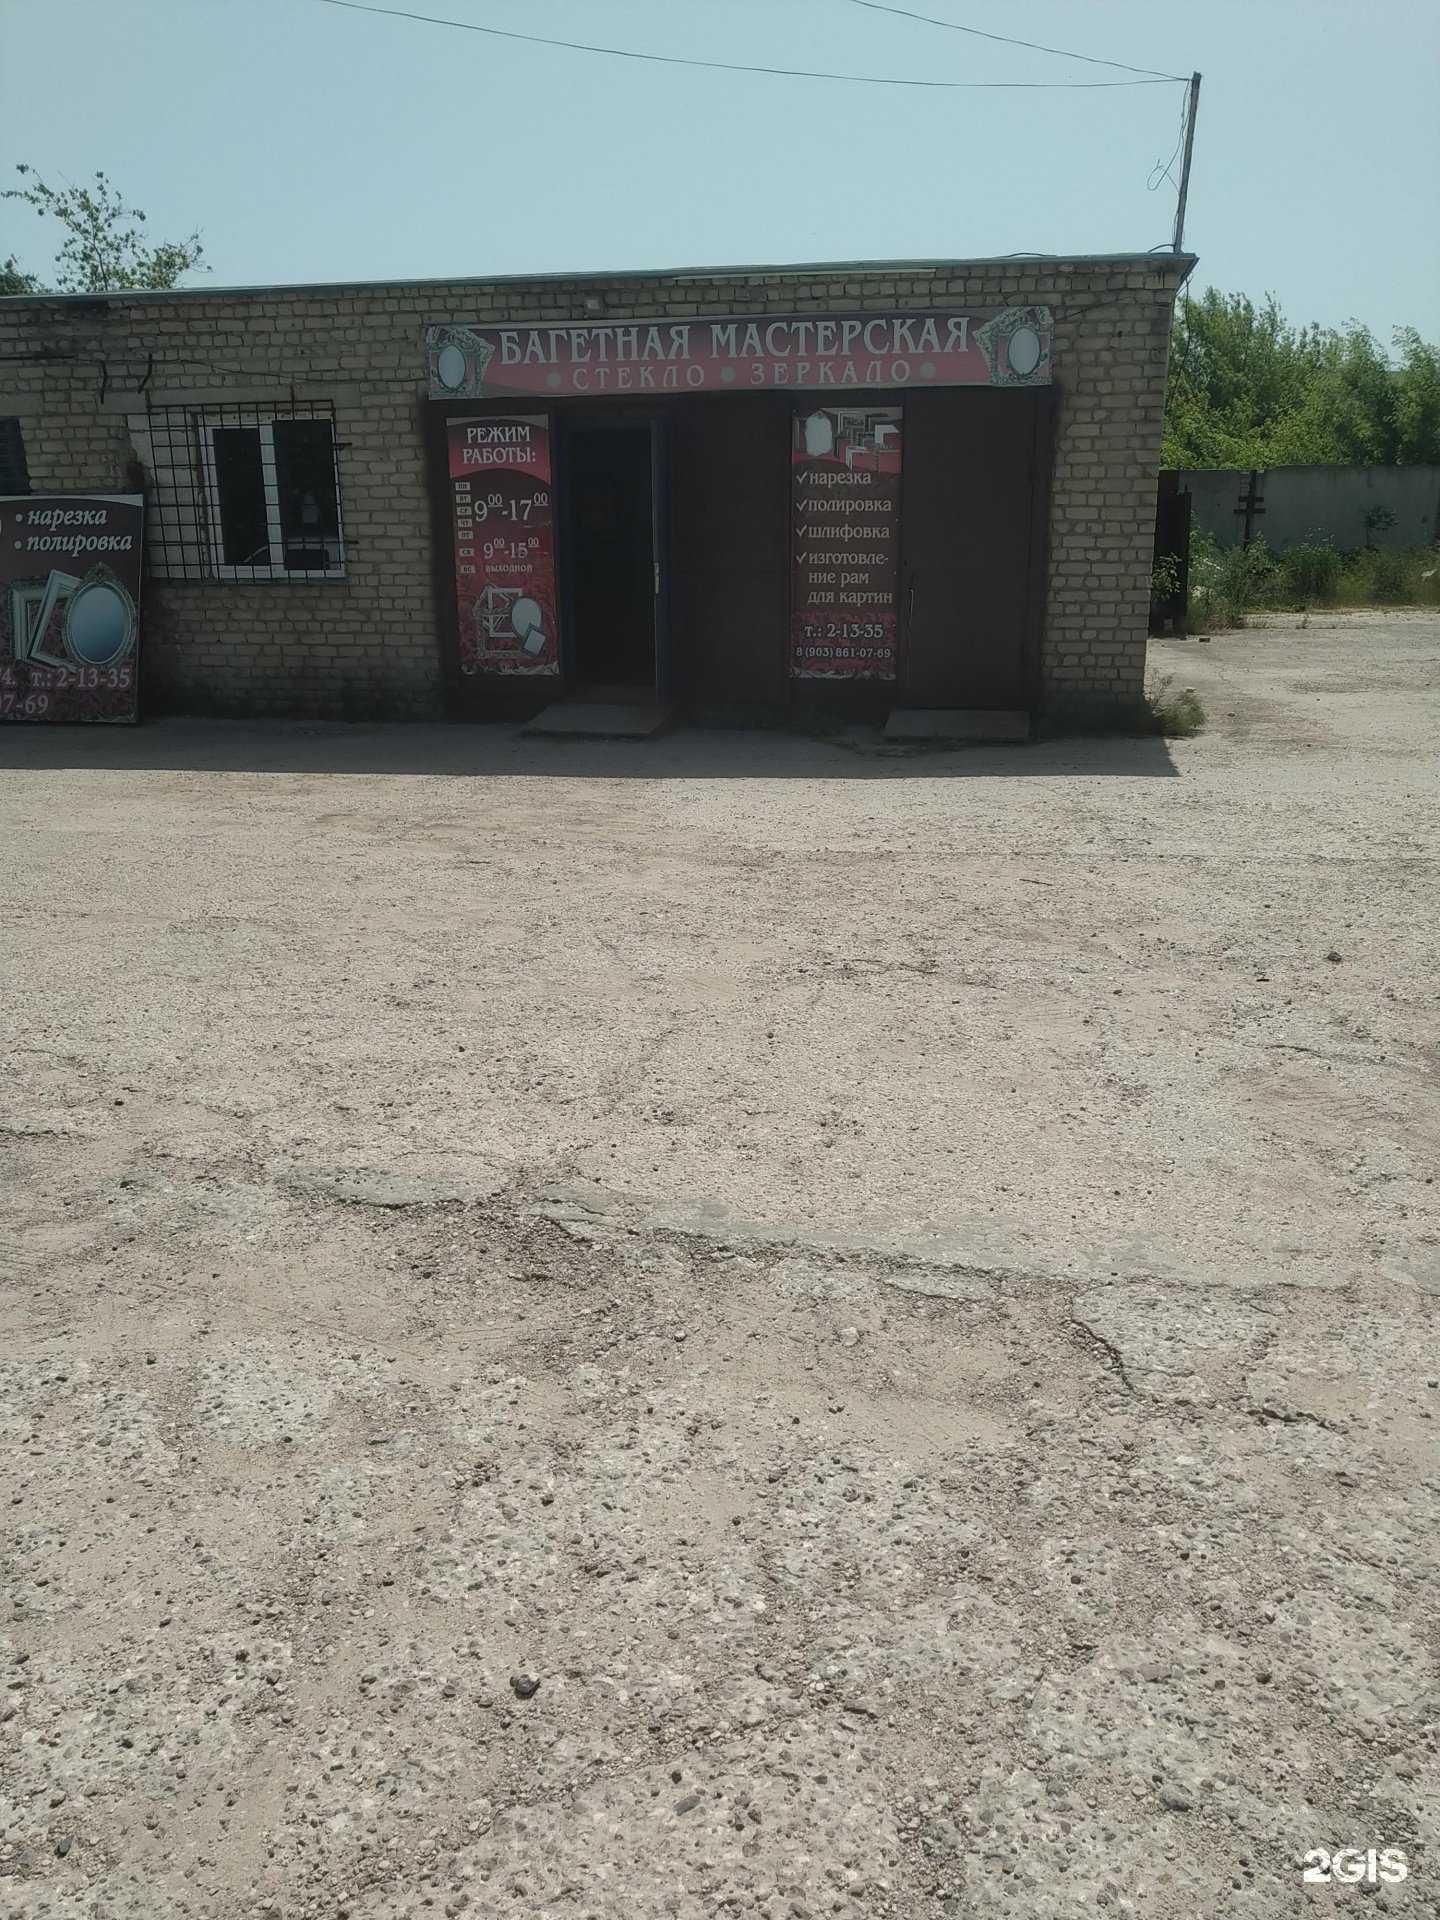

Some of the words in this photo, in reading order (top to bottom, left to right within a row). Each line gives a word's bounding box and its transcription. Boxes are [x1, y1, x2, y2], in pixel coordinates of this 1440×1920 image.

[499, 325, 692, 364] БАГЕТНАЯ
[709, 317, 971, 360] МАСТЕРСКАЯ
[572, 364, 706, 391] СТЕКЛО
[750, 358, 912, 387] ЗЕРКАЛО
[466, 426, 531, 444] РЕЖИМ
[463, 448, 537, 464] РАБОТЫ:
[809, 472, 872, 489] нарезка
[808, 499, 892, 516] полировка
[27, 508, 108, 532] нарезка
[808, 524, 891, 543] шлифовка
[26, 533, 133, 558] полировка
[808, 553, 889, 568] изготовле-
[808, 571, 837, 585] ние
[840, 571, 870, 588] рам
[807, 590, 836, 606] для
[839, 591, 893, 609] картин
[826, 623, 885, 640] 2-13-35
[805, 647, 834, 659] (903)
[56, 667, 130, 688] 2-13-35
